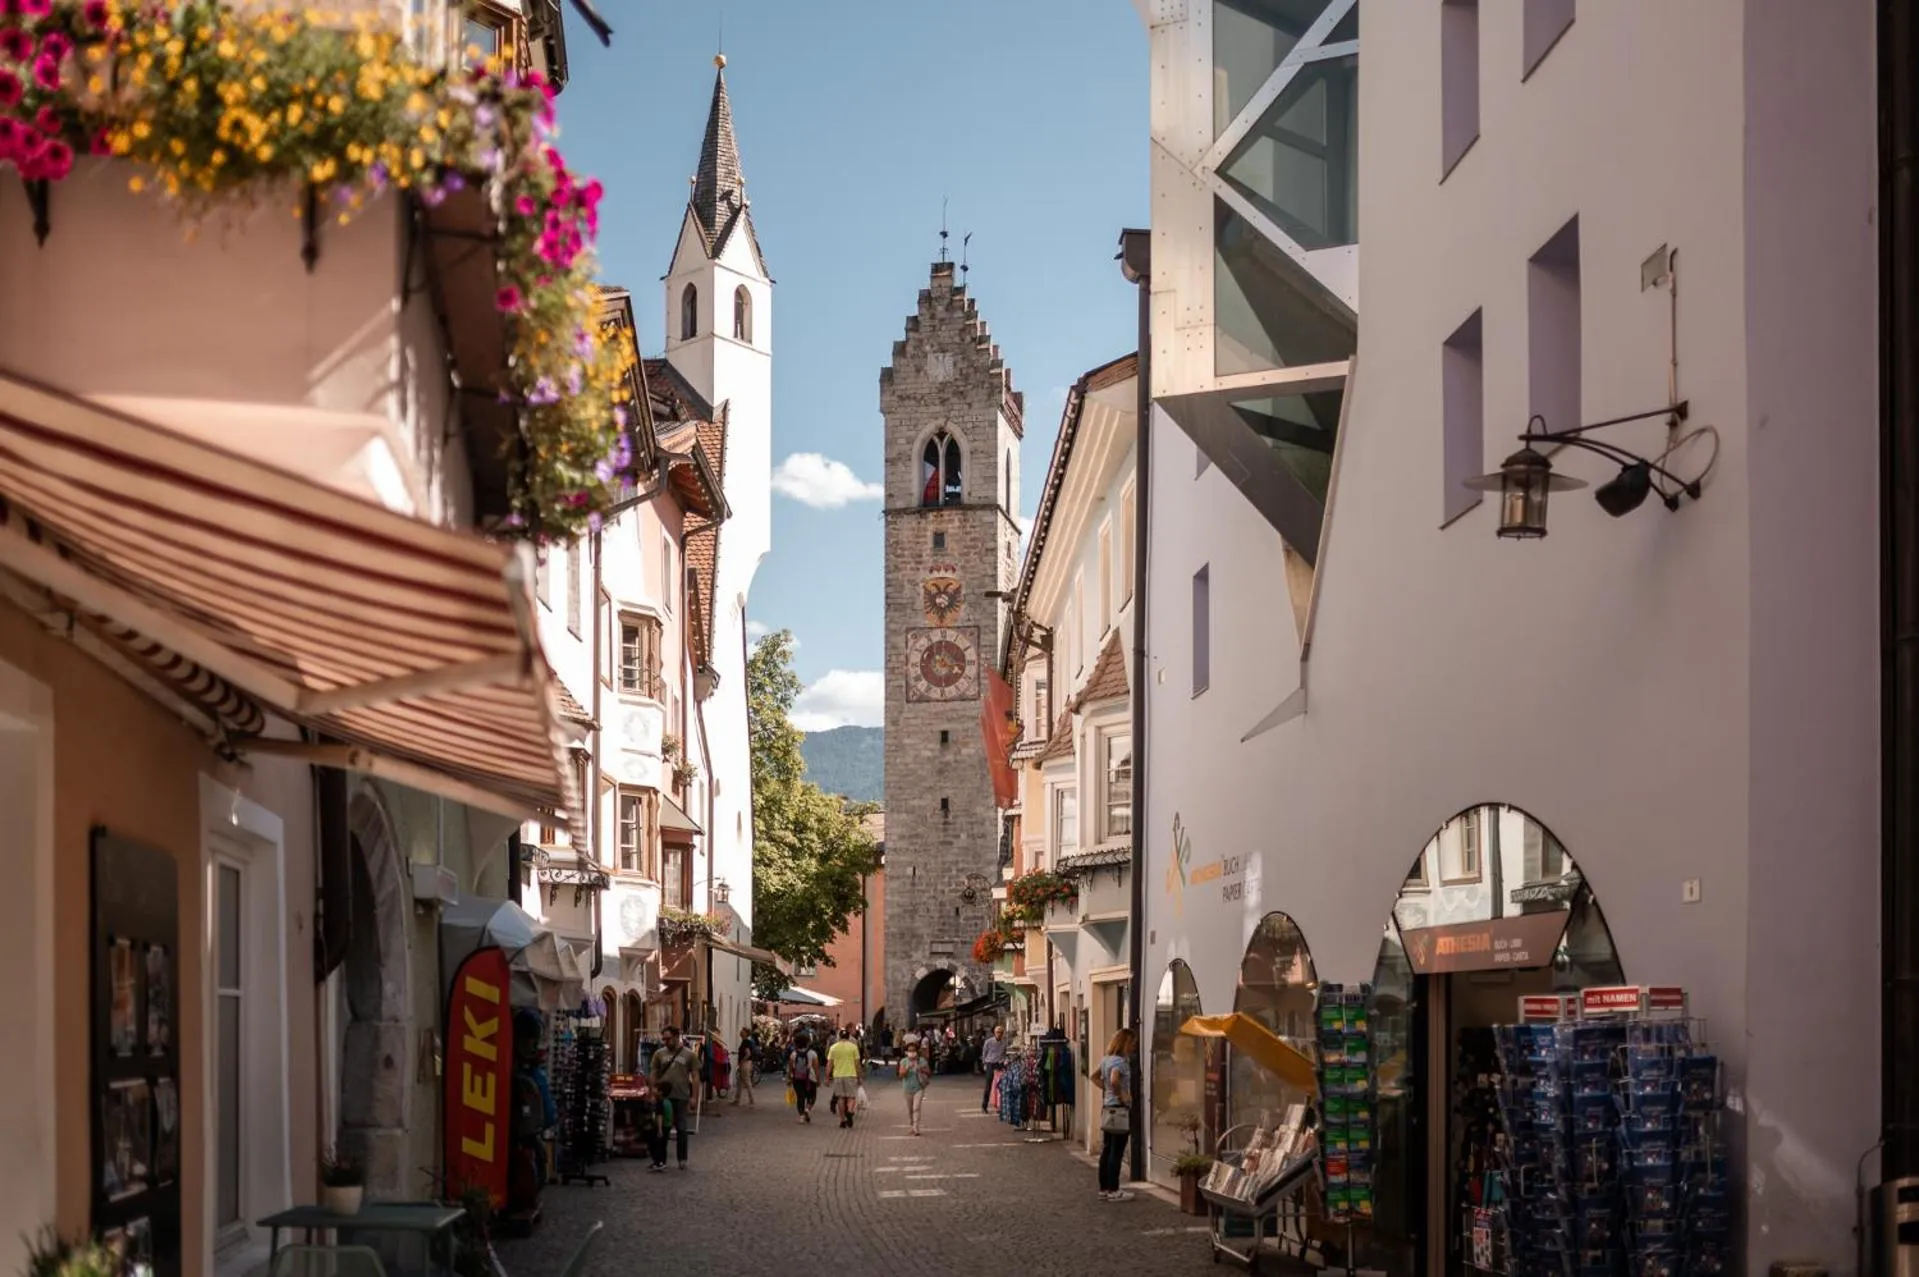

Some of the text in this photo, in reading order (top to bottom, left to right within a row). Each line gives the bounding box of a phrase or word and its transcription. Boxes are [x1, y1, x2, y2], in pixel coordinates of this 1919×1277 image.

[1435, 932, 1491, 956] ATHESIA
[1586, 993, 1637, 1004] mit NAMEN
[462, 976, 500, 1163] LEKI
